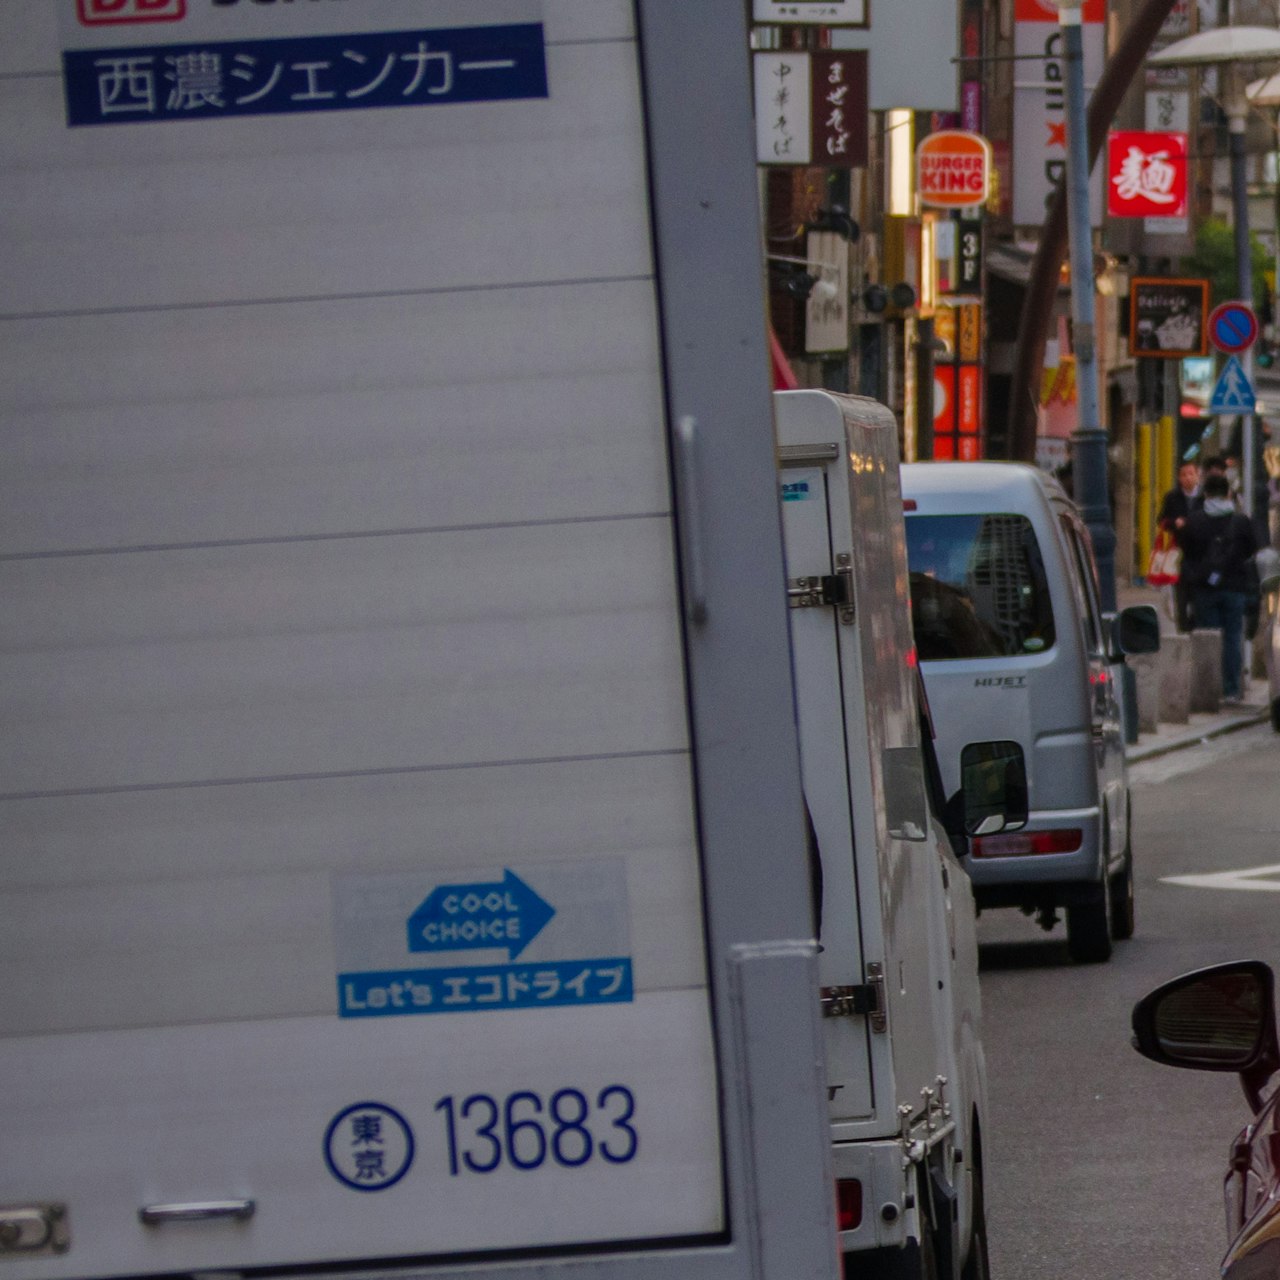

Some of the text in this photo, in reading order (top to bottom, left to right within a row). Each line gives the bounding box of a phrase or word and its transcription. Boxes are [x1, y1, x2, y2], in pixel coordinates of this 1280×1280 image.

[94, 42, 516, 115] 西濃シェンカー
[920, 157, 983, 170] BURGER
[1111, 145, 1177, 205] 麺
[920, 172, 983, 191] KING
[974, 676, 1026, 687] HIJET
[442, 892, 518, 915] COOL
[421, 917, 521, 943] CHOICE
[345, 964, 626, 1010] Let's エコドライブ
[434, 1084, 639, 1177] 13683
